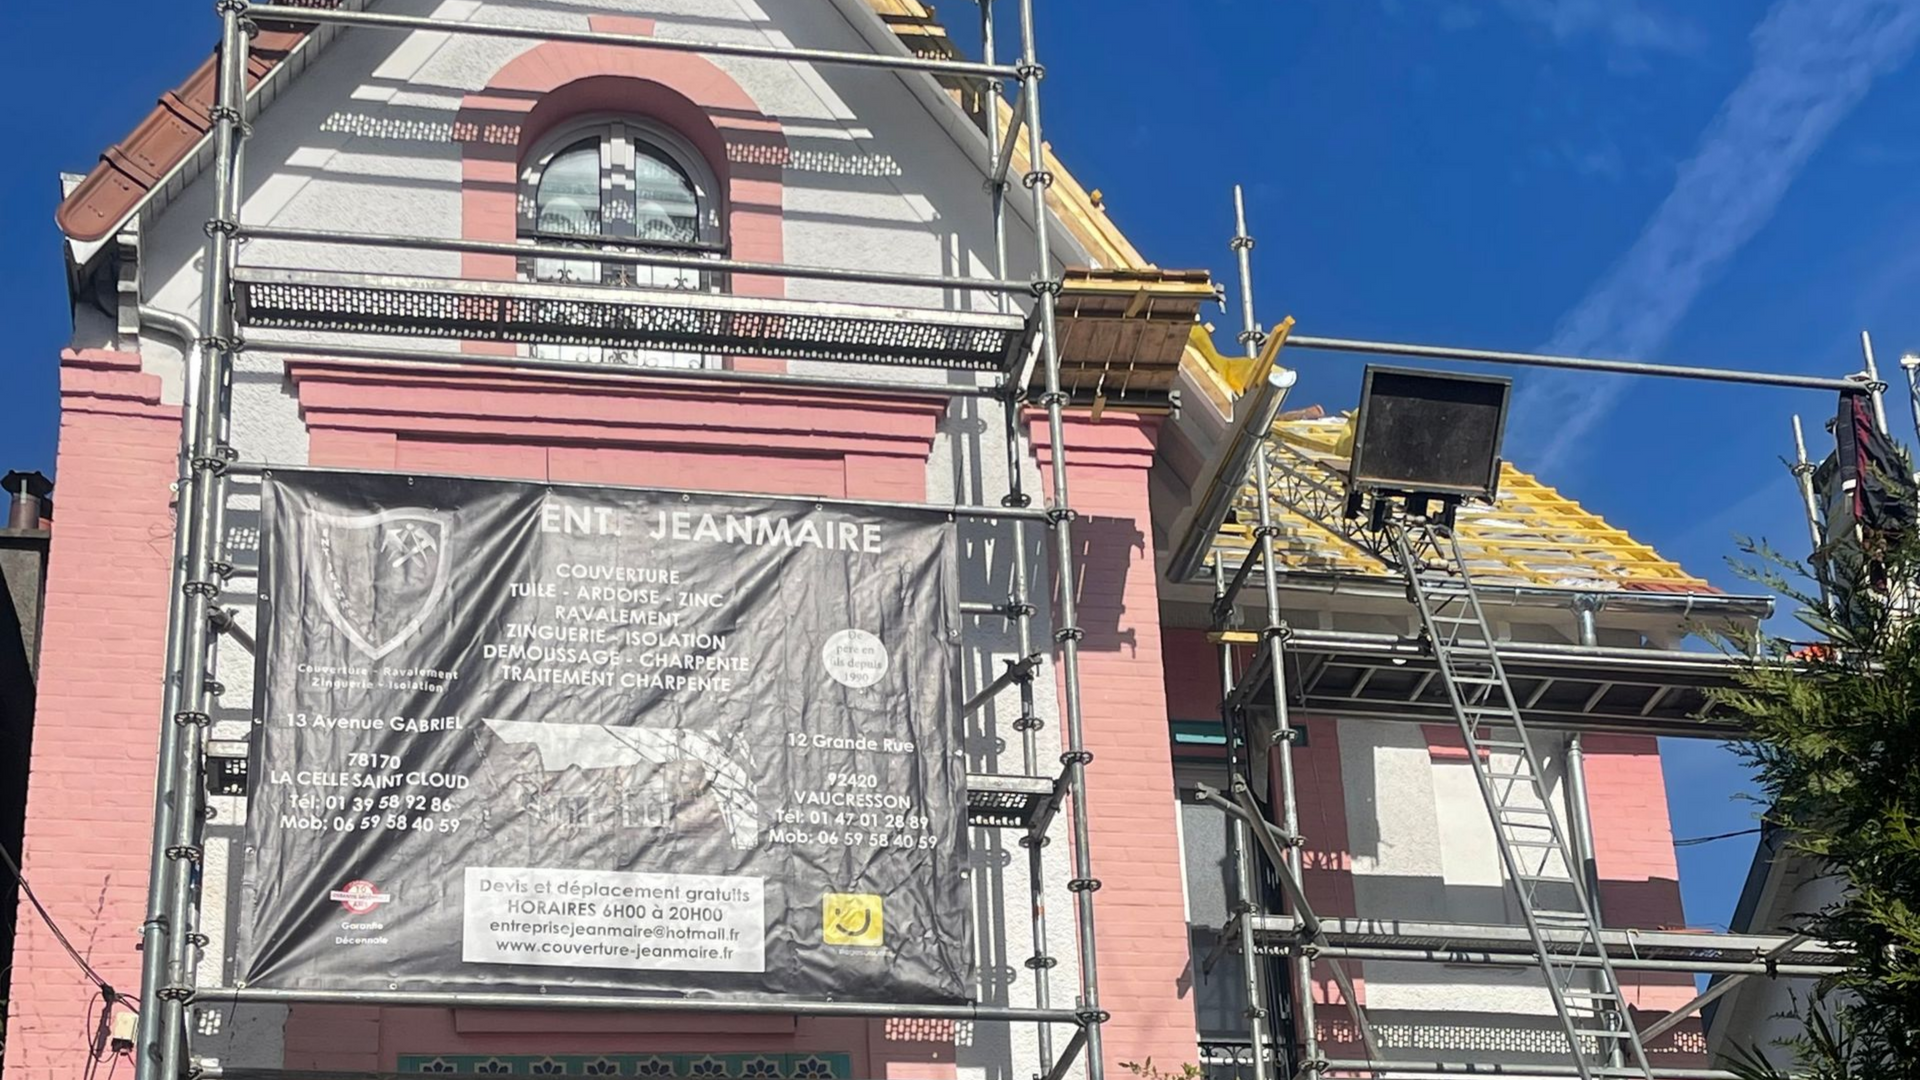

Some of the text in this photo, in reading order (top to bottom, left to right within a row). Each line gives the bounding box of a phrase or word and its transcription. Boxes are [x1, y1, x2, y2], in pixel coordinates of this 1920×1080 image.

[650, 510, 882, 554] JEANMAIRE
[556, 563, 680, 585] COUVERTURE
[509, 583, 556, 598] TUILE
[577, 586, 660, 605] ARDOISE
[678, 592, 724, 608] ZINC
[555, 605, 681, 627] RAVALEMENT
[506, 623, 606, 643] ZINGUERIE
[626, 633, 726, 651] ISOLATION
[483, 644, 620, 666] DEMOUSSAGE
[639, 652, 750, 672] CHARPENTE
[298, 663, 368, 676] Couverture
[383, 666, 458, 680] Ravalement
[501, 665, 732, 692] TRAITEMENT CHARPENTE
[388, 680, 443, 693] Isolation
[286, 713, 463, 733] 13 Avenue GABRIEL
[787, 733, 915, 753] 12 Grande Rue
[347, 753, 401, 769] 78170
[270, 770, 470, 790] LA CELLE SAINT CLOUD
[828, 773, 878, 788] 92420
[289, 794, 452, 812] Tél: 01 39 58 92 86
[793, 790, 911, 809] VAUCRESSON
[280, 815, 461, 833] Mob: 06 59 58 40 59
[809, 811, 829, 825] 01
[834, 812, 856, 826] 47
[860, 814, 879, 827] 01
[884, 815, 906, 828] 28
[909, 816, 930, 830] 89
[768, 829, 938, 850] Mob: 06 59 58 40 59
[480, 879, 751, 903] Devis et déplacement gratuits
[507, 899, 724, 922] HORAIRES 6H00 à 20H00
[489, 919, 741, 941] entreprisejeanmaire@hotmail.fr
[496, 940, 735, 960] www.couverture-jeanmaire.fr
